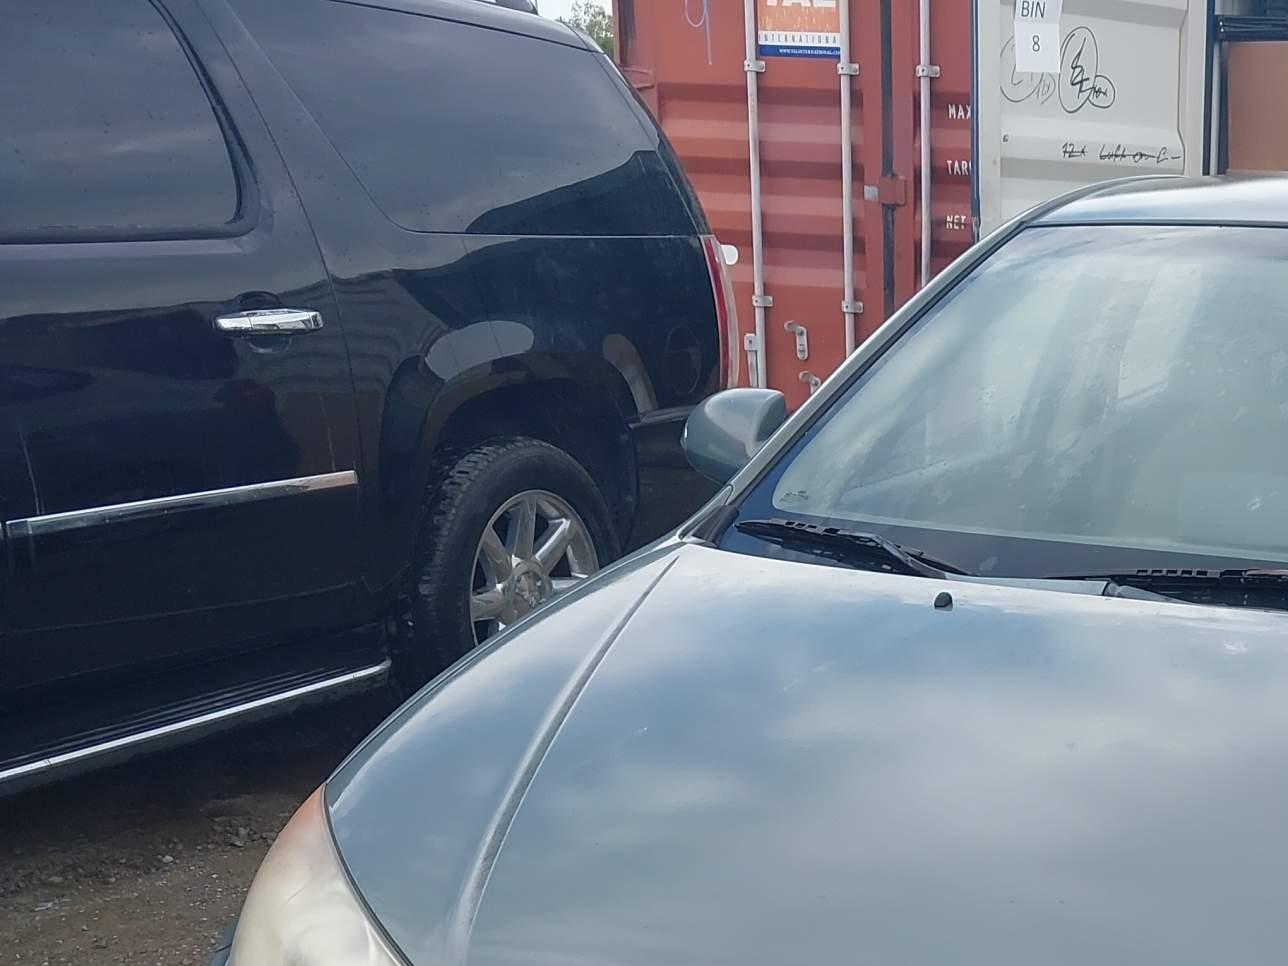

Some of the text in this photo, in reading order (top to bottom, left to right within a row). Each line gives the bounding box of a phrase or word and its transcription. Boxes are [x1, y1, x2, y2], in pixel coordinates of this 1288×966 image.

[1021, 0, 1046, 18] BIN
[759, 31, 840, 45] INTERNATIONA
[1032, 35, 1041, 52] 8
[945, 215, 967, 231] NET
